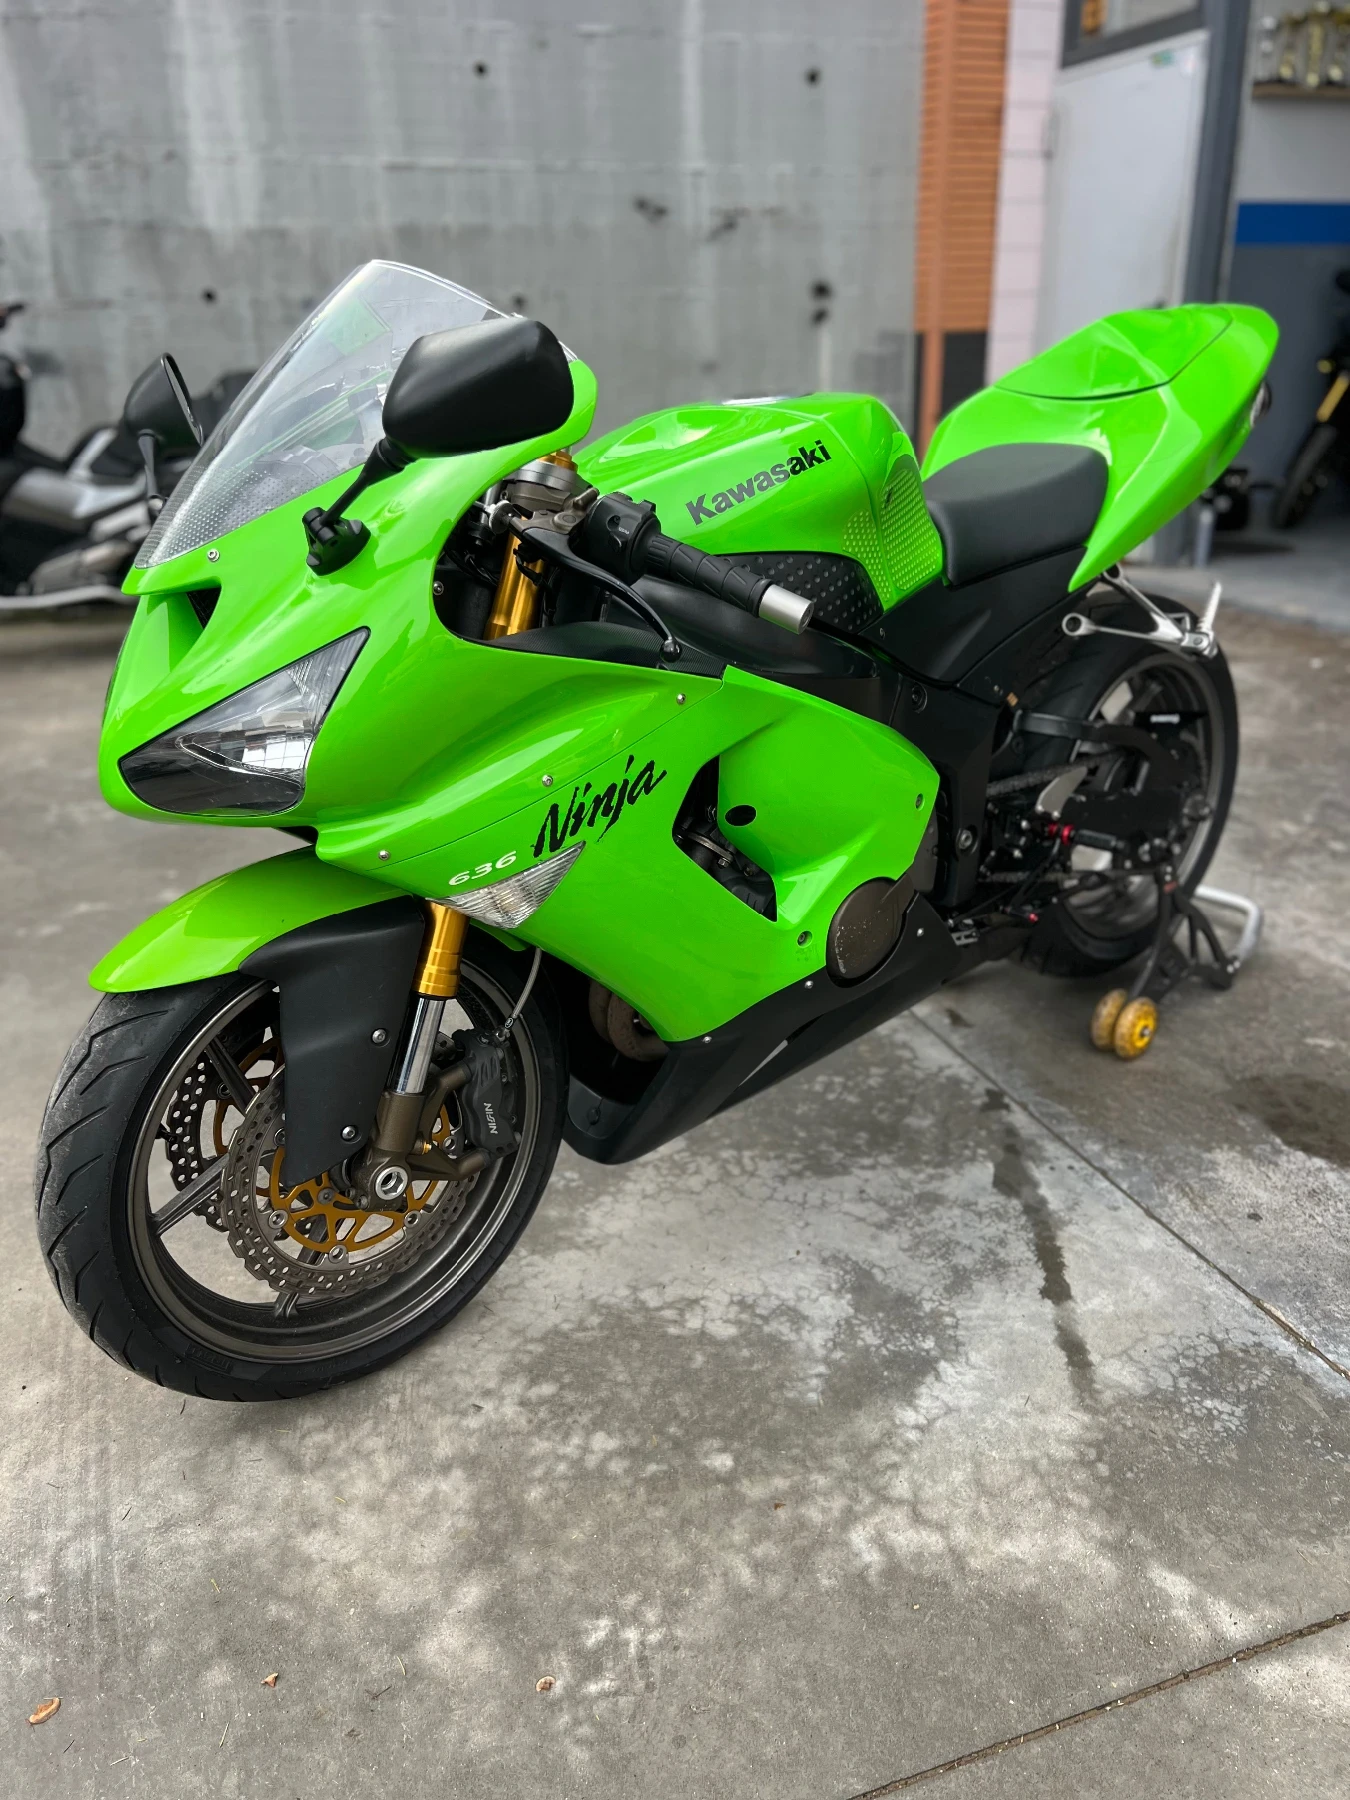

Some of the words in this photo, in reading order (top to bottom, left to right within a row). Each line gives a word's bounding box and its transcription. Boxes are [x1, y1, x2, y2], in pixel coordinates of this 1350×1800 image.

[685, 439, 831, 525] Kawasaki
[532, 755, 667, 858] Ninja
[448, 850, 517, 886] 636
